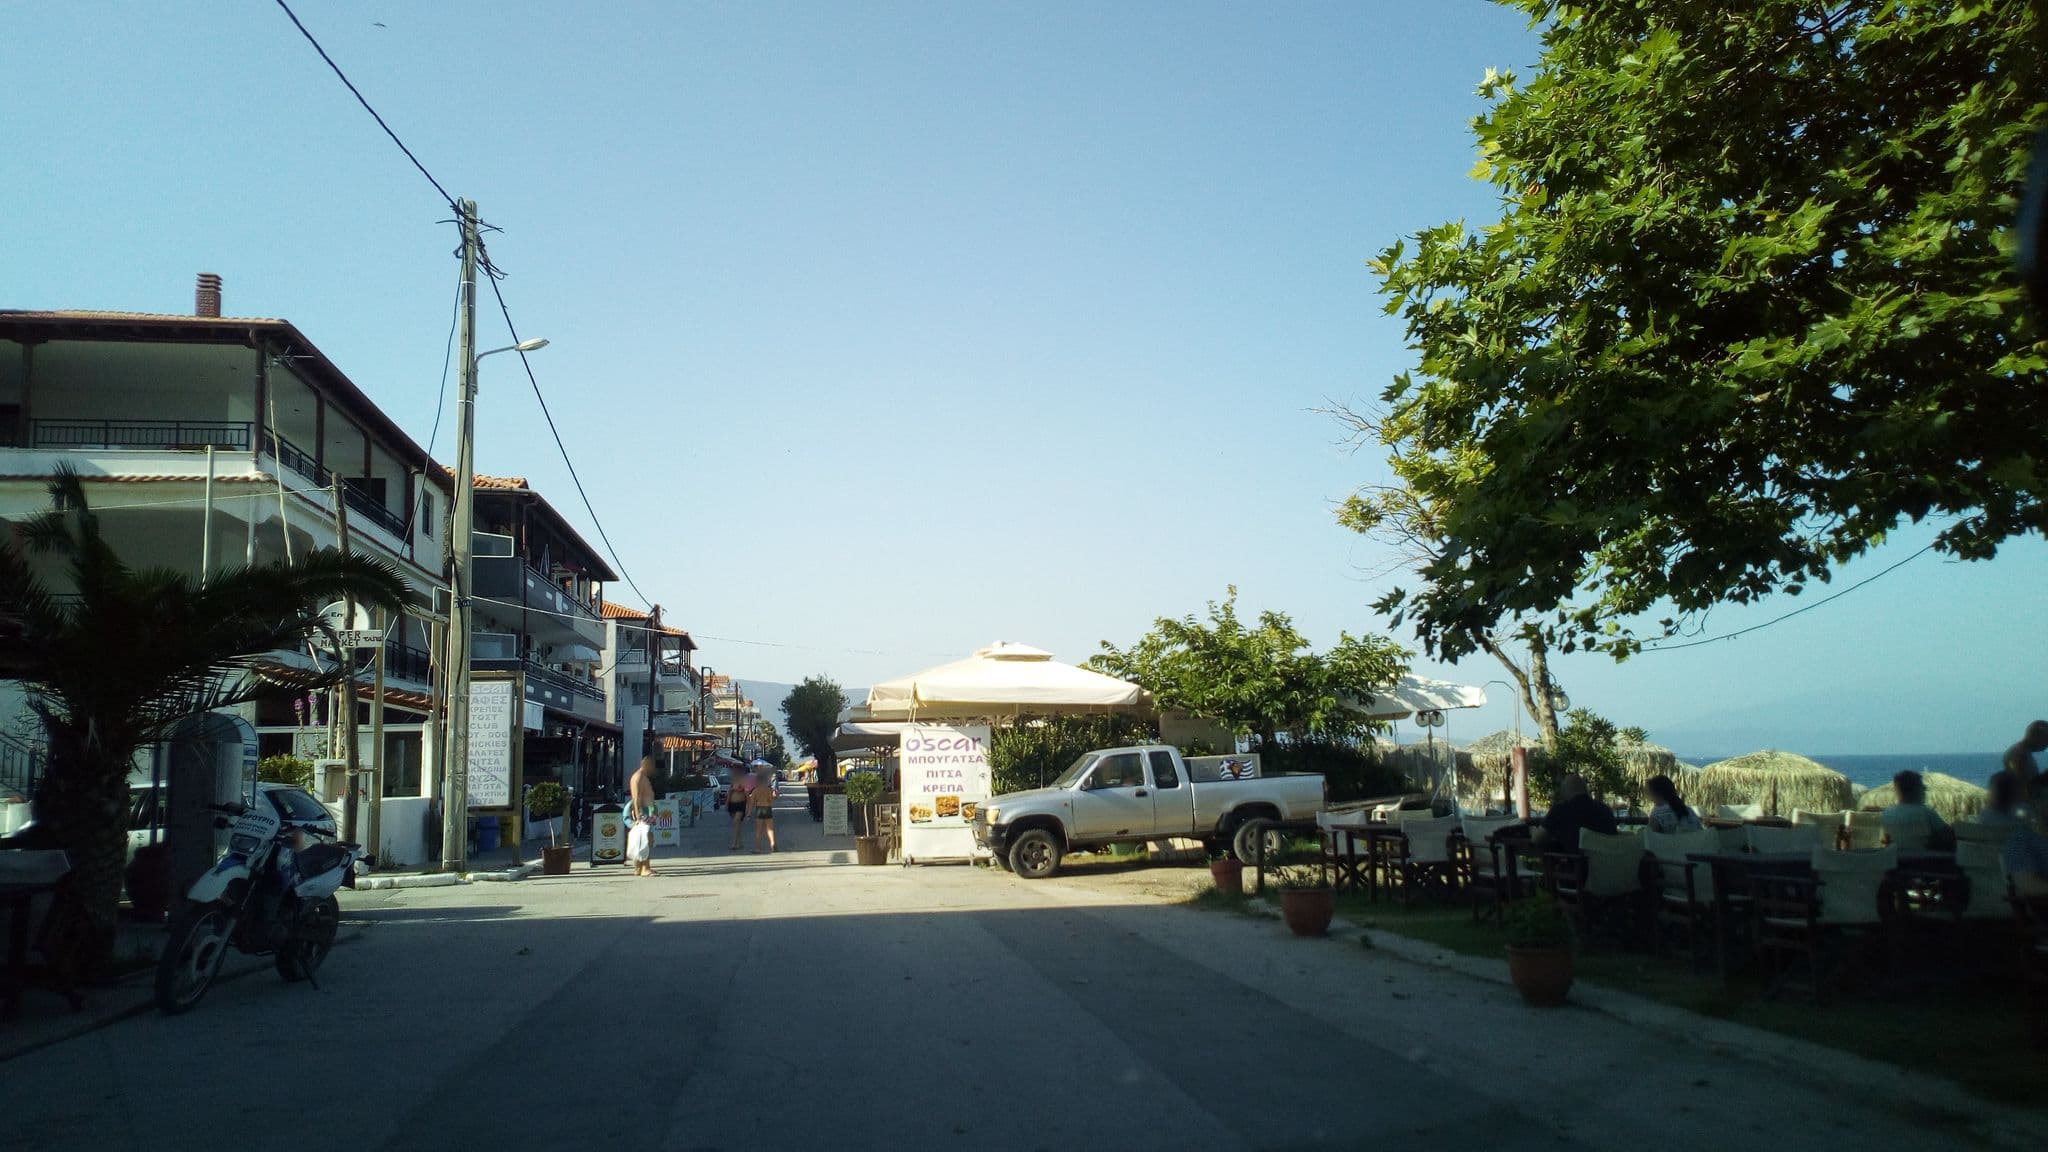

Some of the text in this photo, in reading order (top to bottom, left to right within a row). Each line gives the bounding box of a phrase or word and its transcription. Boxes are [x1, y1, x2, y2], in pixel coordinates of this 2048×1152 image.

[320, 639, 360, 647] MAKET
[470, 684, 512, 695] scar
[470, 696, 508, 705] ΑΦΕΣ
[470, 722, 498, 730] CLUB
[905, 737, 982, 752] oscar
[908, 755, 984, 764] ΜΠΟΥΓΑΤΣΑ
[926, 770, 962, 778] ΠΙΤΣΑ
[923, 784, 964, 792] ΚΡΕΠΑ
